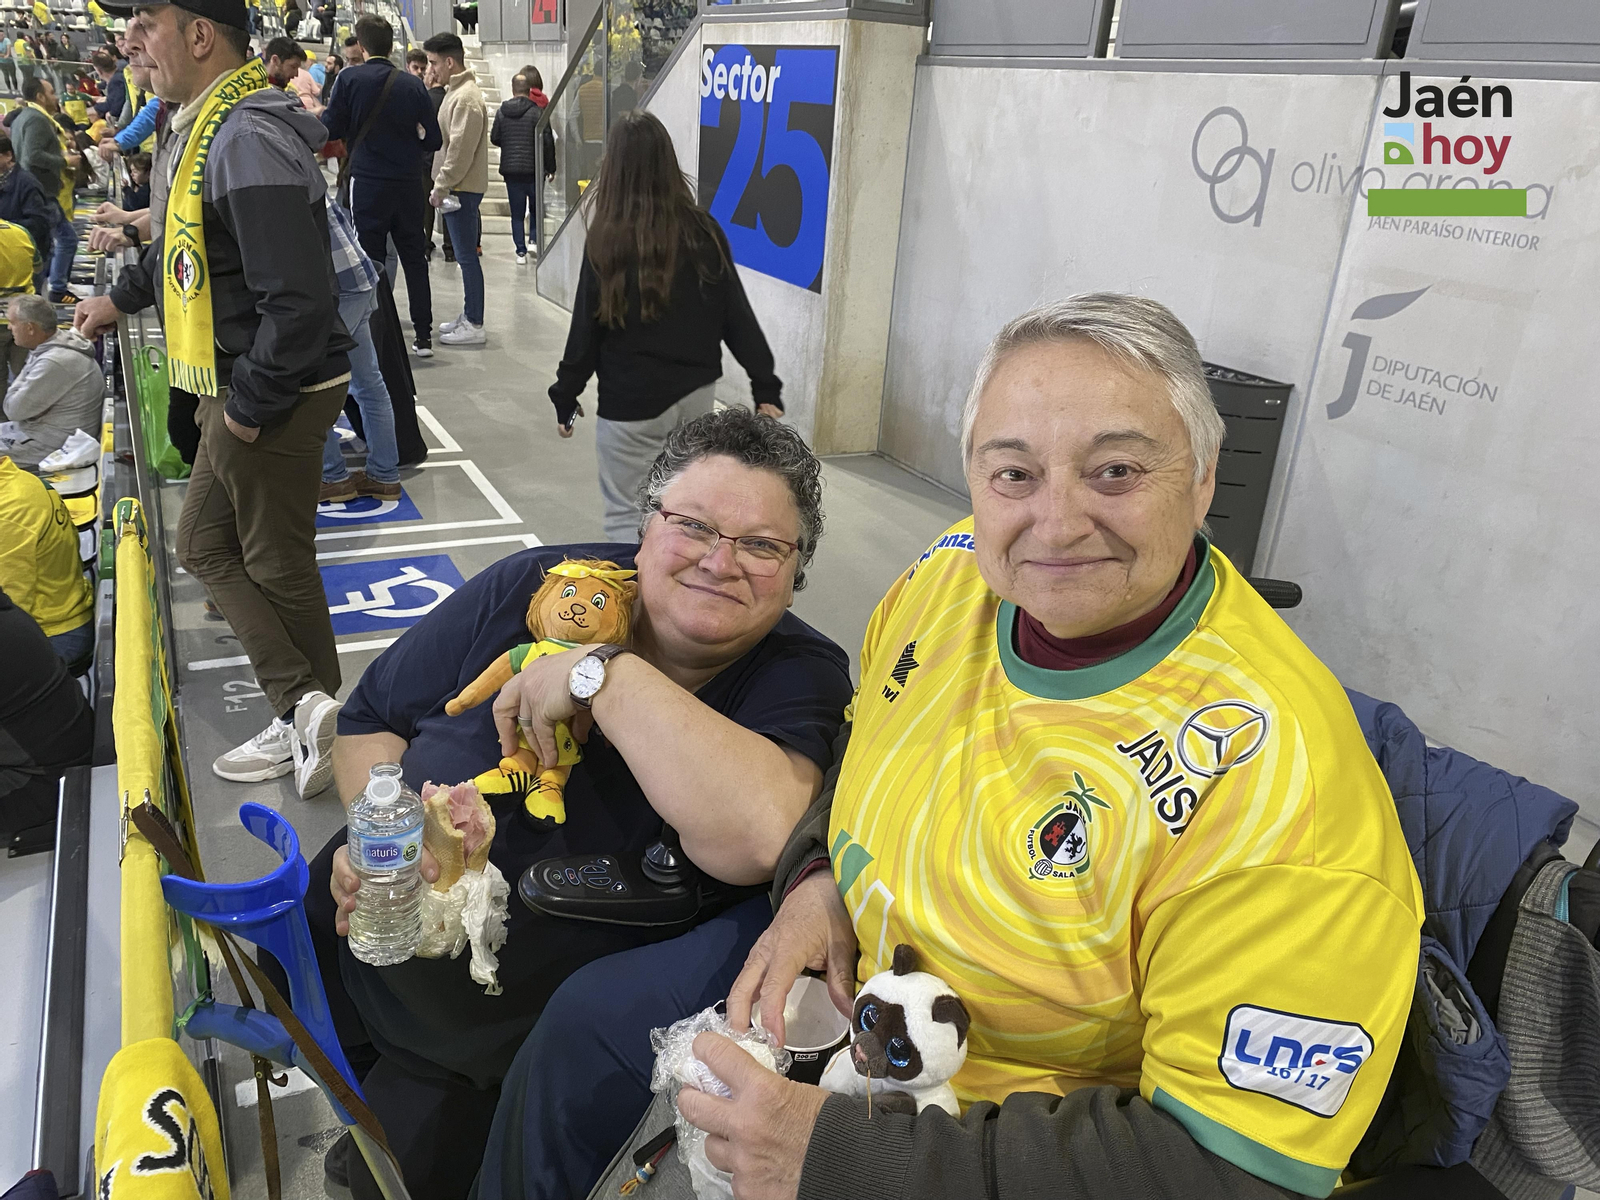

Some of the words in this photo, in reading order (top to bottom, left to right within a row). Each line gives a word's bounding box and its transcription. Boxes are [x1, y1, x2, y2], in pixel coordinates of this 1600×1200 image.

[701, 47, 782, 103] Sector
[700, 44, 837, 290] 25
[1402, 217, 1464, 241] PARAÍSO
[1466, 227, 1541, 251] INTERIOR
[1371, 355, 1499, 403] DIPUTACIÓN
[1366, 379, 1394, 400] DE
[1393, 388, 1447, 416] JAÉN
[365, 846, 398, 858] naturis
[1027, 829, 1037, 860] FUTBOL
[1052, 870, 1076, 879] SALA
[1305, 1073, 1331, 1091] 17
